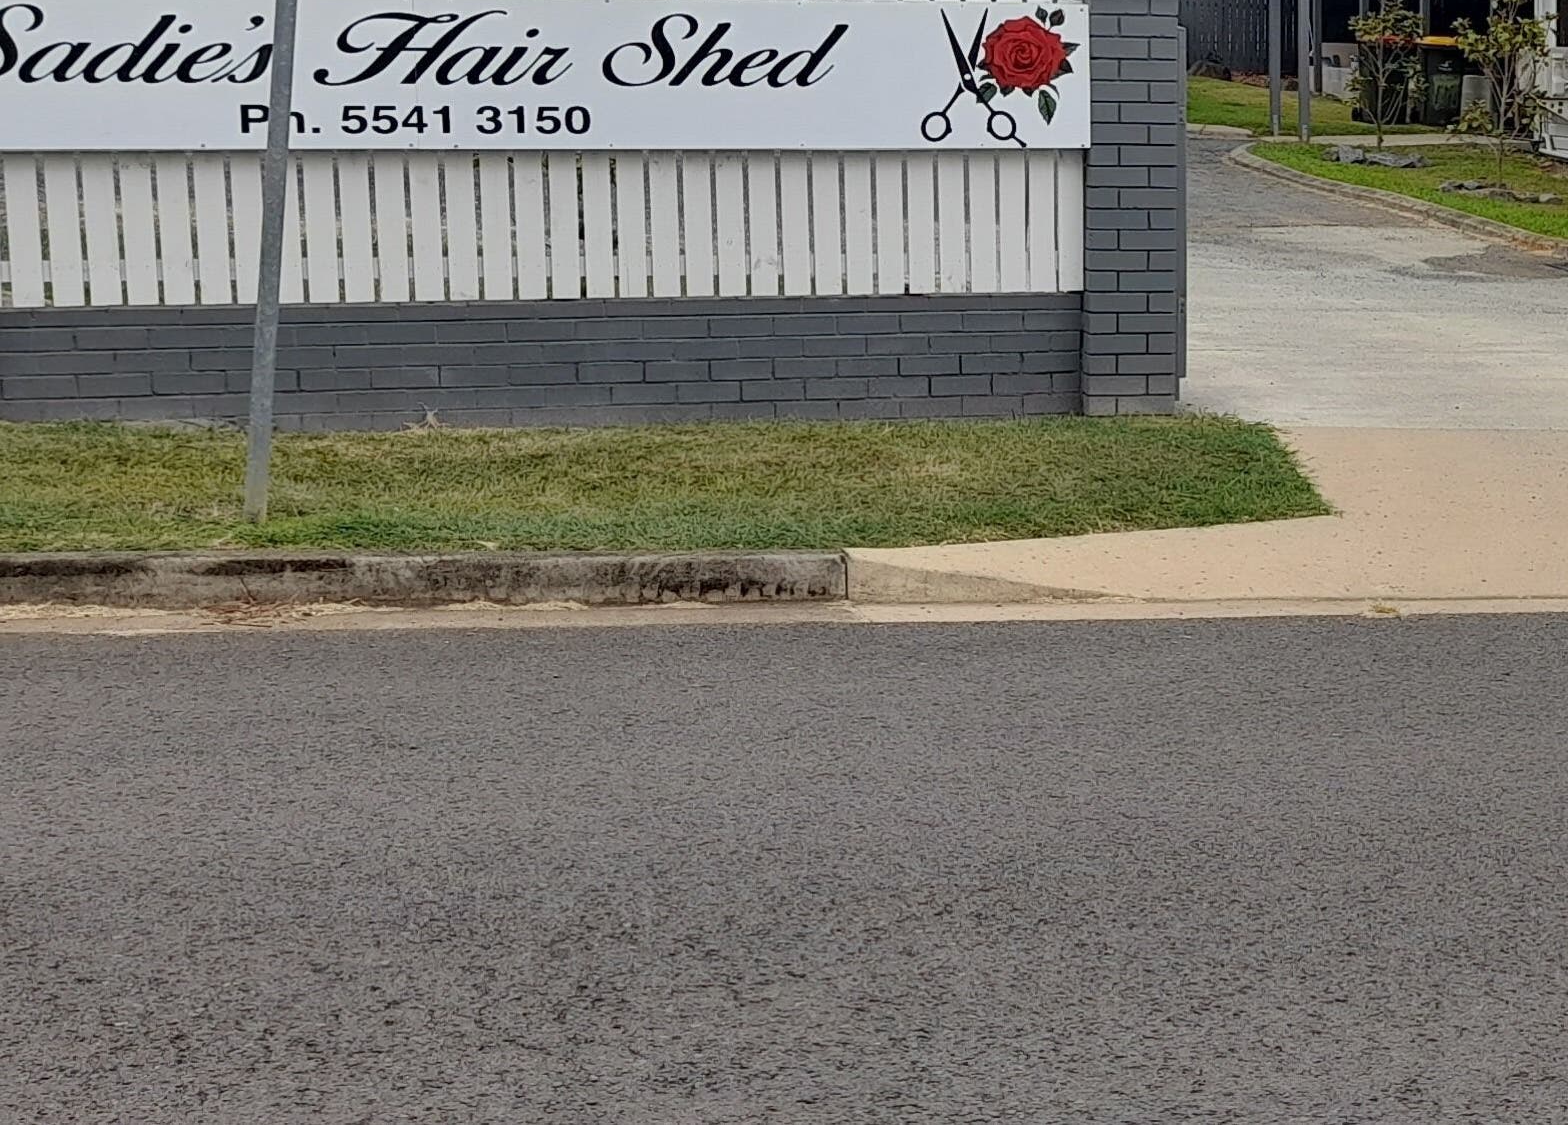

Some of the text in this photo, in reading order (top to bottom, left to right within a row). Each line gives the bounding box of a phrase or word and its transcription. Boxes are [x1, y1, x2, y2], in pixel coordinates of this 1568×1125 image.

[0, 3, 849, 88] Sadie's Hair Shed
[341, 105, 451, 135] 5541
[476, 105, 591, 135] 3150
